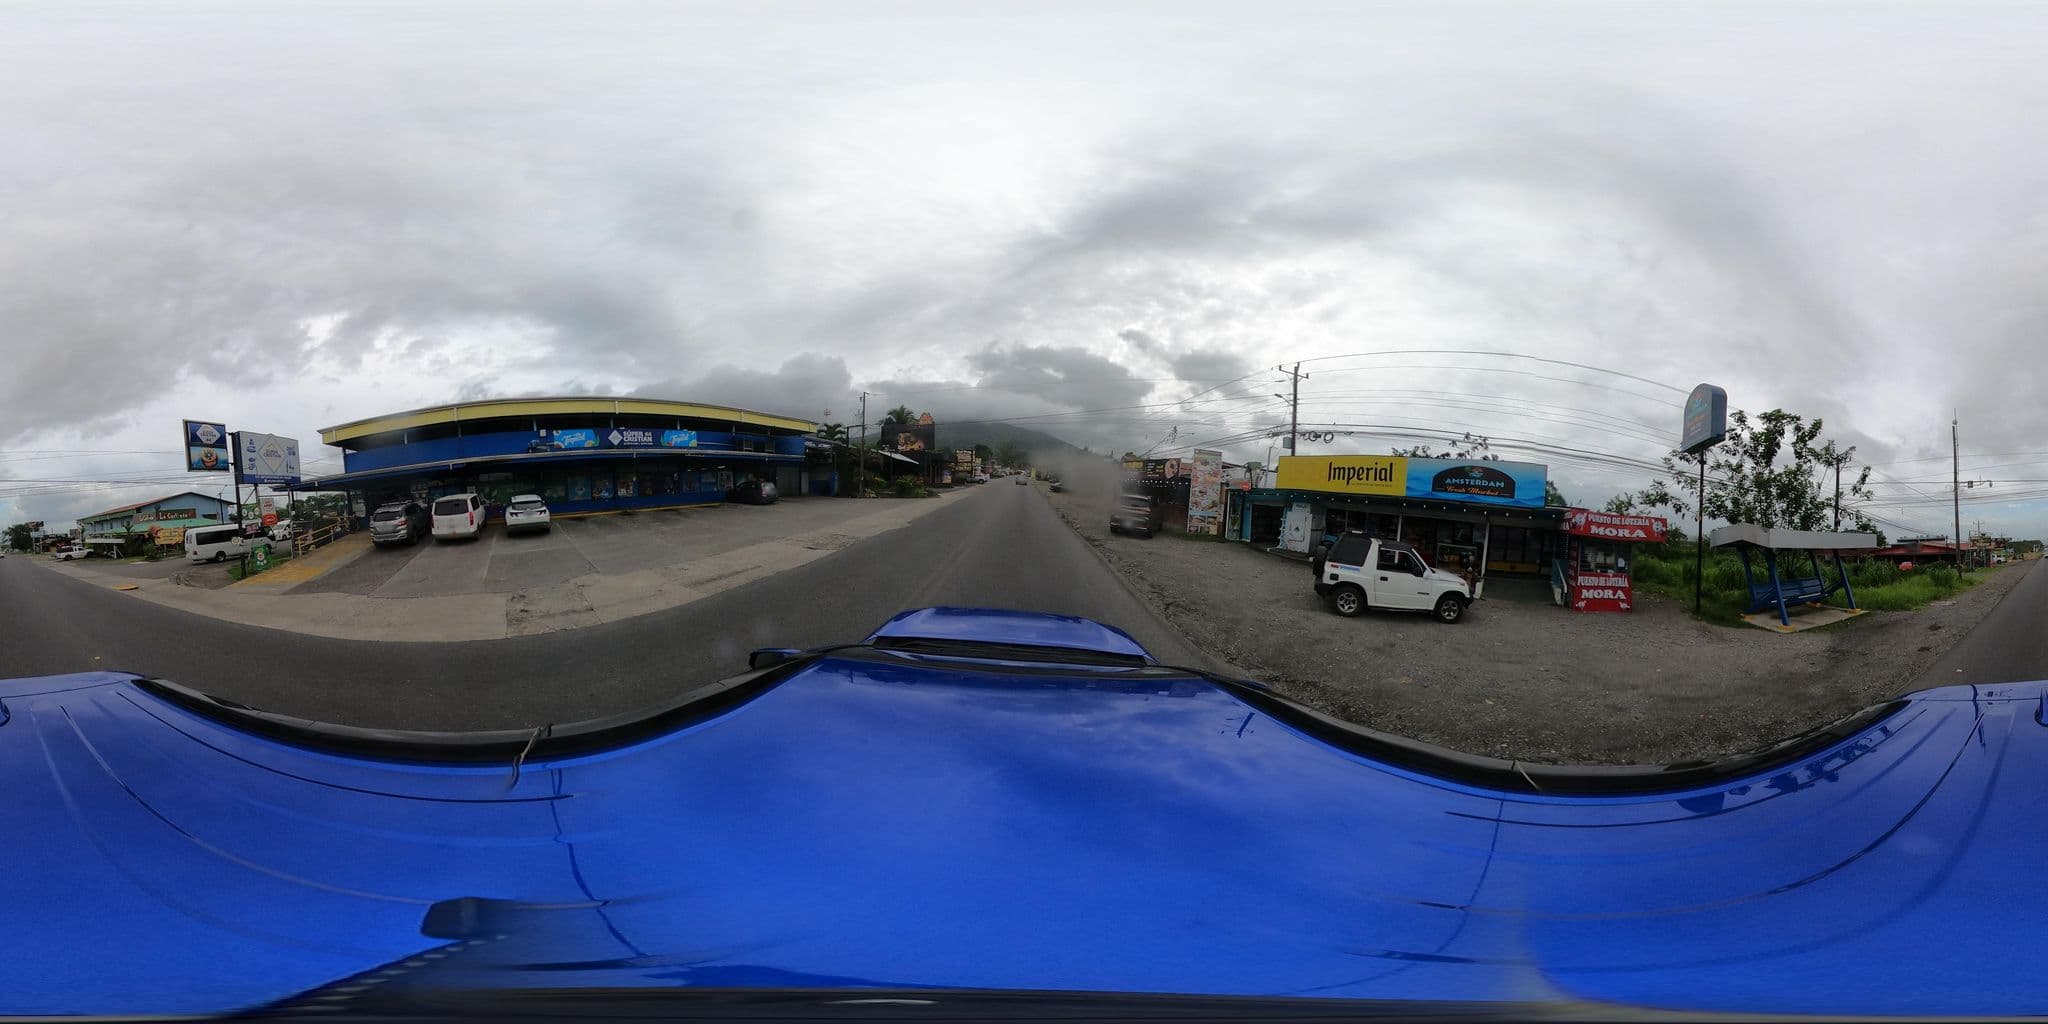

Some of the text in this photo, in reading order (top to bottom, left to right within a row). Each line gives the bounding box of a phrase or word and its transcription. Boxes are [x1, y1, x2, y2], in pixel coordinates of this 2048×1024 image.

[1328, 461, 1393, 486] Imperial
[1445, 478, 1504, 488] AMSTERDAM
[1468, 487, 1500, 496] Market
[1588, 513, 1649, 526] PUESTO DE LOTERÍA
[1590, 525, 1647, 538] MORA
[1577, 575, 1629, 587] PUESTO DE LOTERÍA
[1581, 589, 1626, 599] MORA
